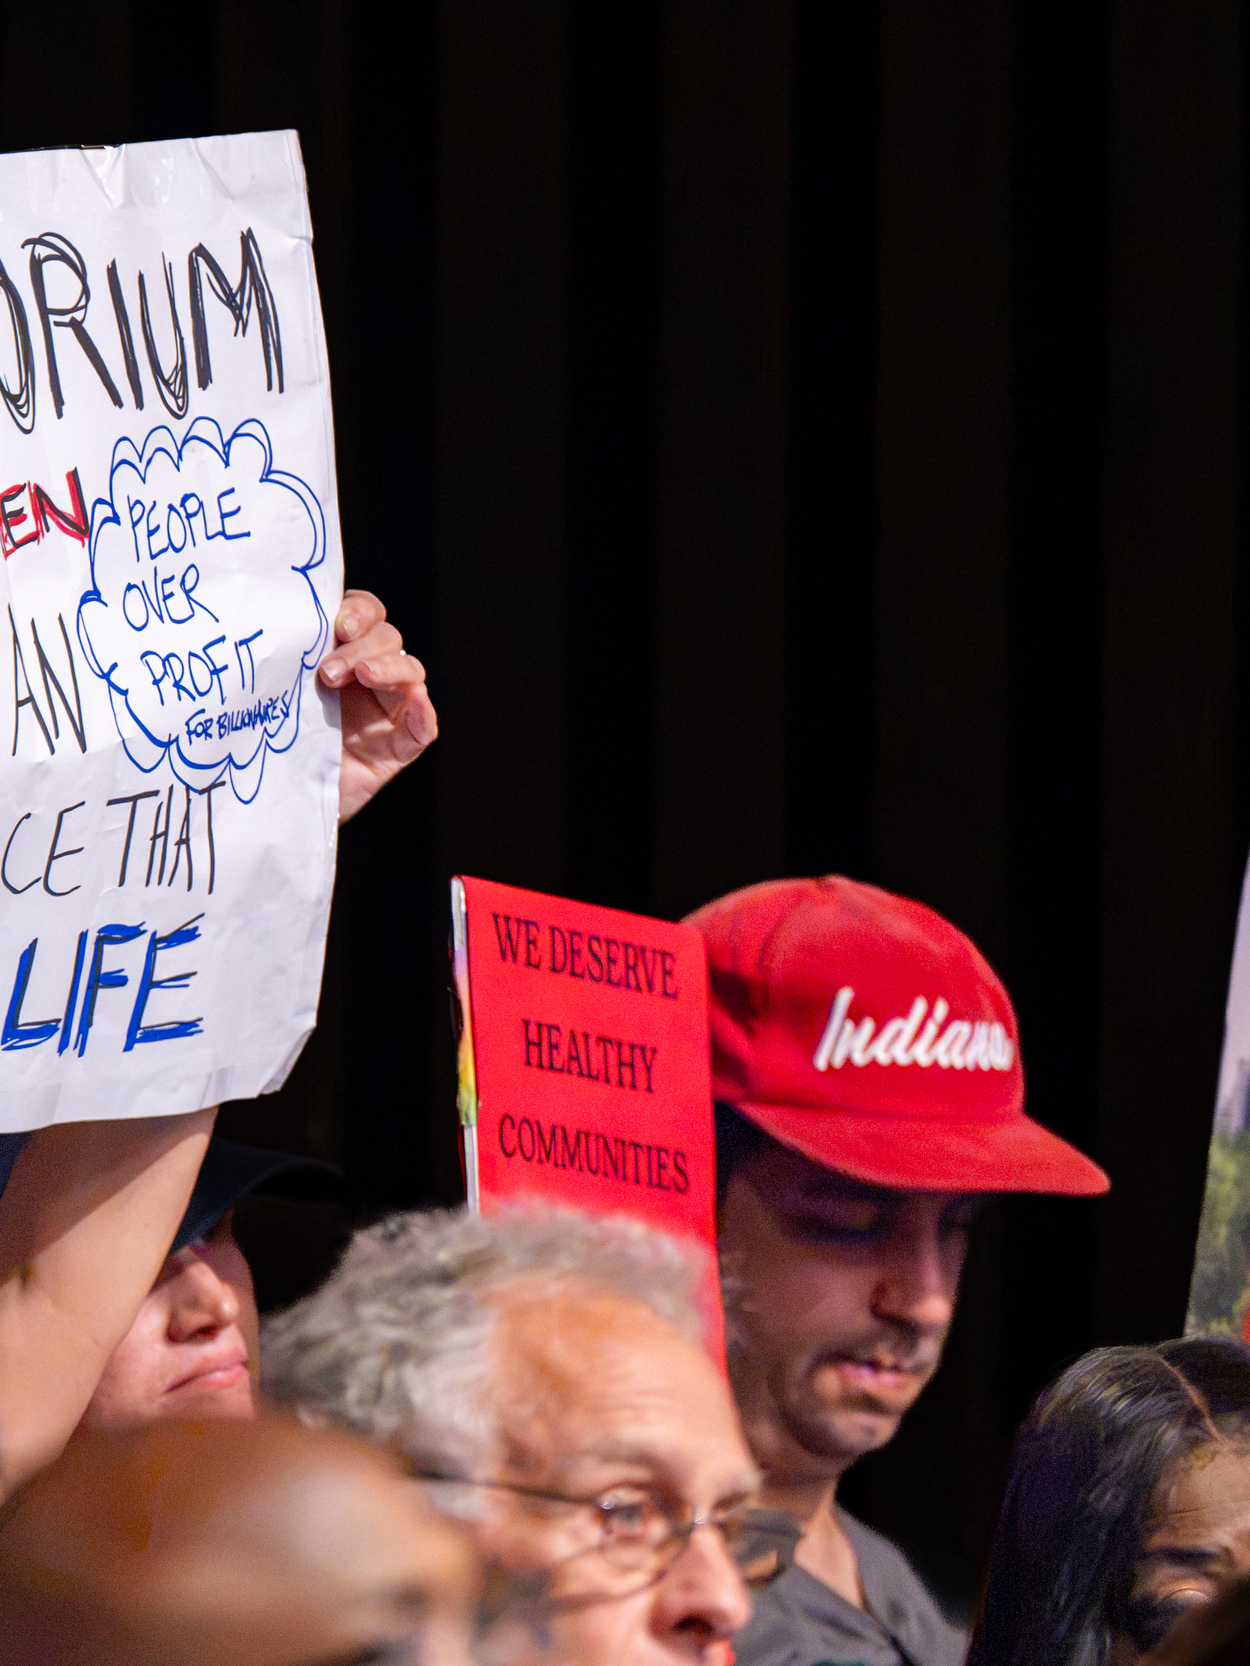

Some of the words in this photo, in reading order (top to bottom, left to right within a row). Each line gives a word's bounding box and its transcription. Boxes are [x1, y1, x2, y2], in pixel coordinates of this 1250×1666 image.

[127, 487, 251, 563] PEOPLE
[122, 563, 220, 632] OVER
[8, 602, 89, 756] AN
[140, 628, 264, 706] PROFIT
[184, 708, 213, 746] FOR
[106, 781, 227, 894] THAT
[0, 912, 206, 1058] LIFE
[491, 912, 543, 971] WE
[547, 924, 679, 1000] DESERVE
[521, 1018, 658, 1094] HEALTHY
[499, 1113, 690, 1194] COMMUNITIES
